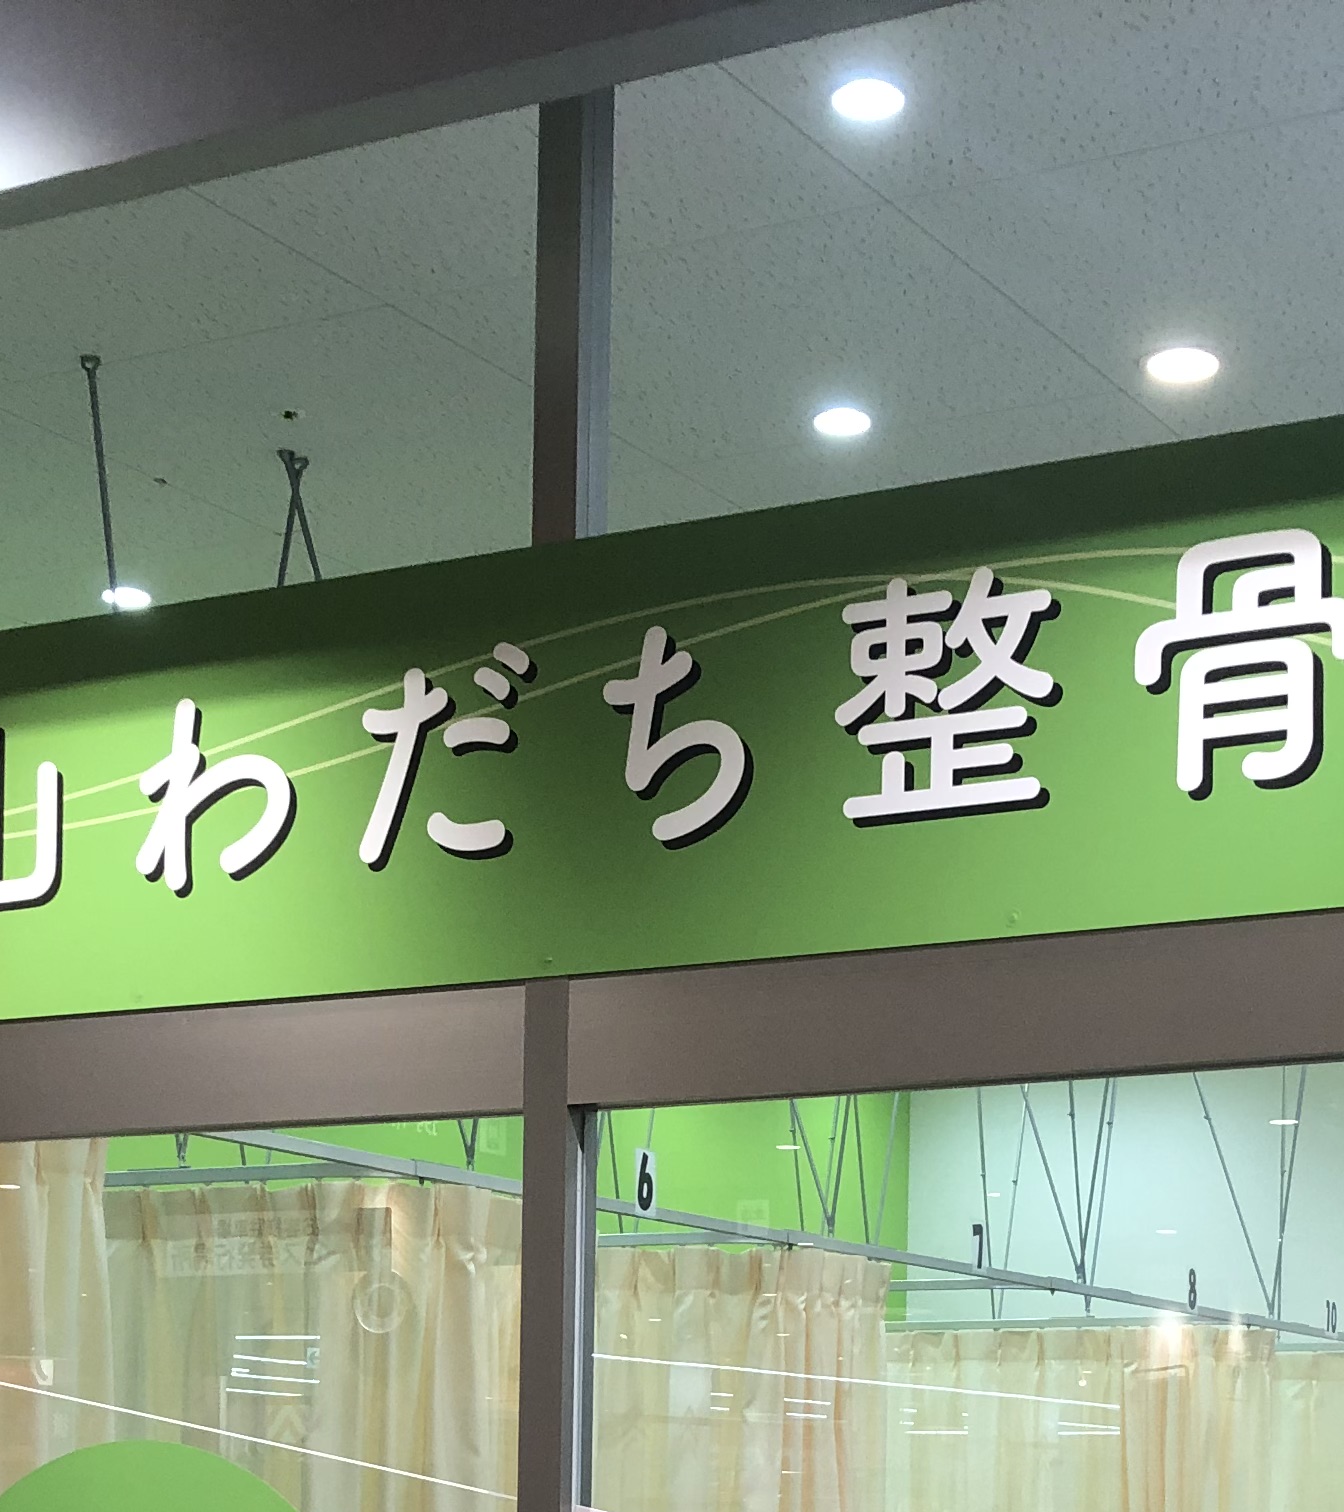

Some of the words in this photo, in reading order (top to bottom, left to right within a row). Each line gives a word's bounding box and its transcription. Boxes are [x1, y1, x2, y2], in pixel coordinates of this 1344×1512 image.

[637, 1152, 654, 1212] 6
[972, 1223, 984, 1269] 7
[1188, 1268, 1198, 1310] 8
[1325, 1300, 1338, 1333] 10
